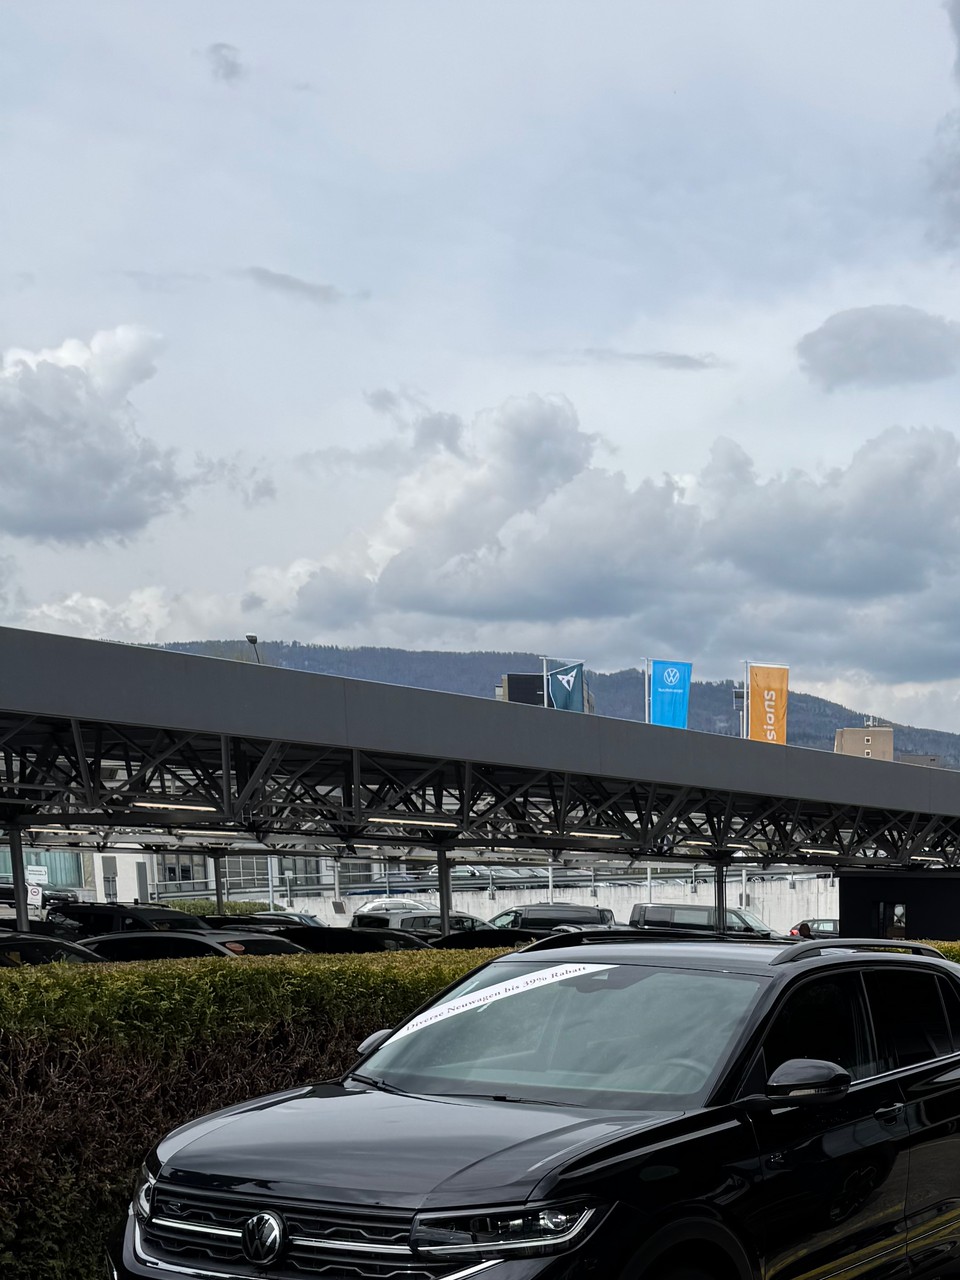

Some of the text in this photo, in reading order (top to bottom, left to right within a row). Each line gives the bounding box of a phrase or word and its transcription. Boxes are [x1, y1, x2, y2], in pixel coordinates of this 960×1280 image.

[763, 690, 777, 743] sions
[407, 1012, 444, 1030] Diverse
[447, 991, 501, 1013] Neuwagen
[504, 984, 520, 993] bis
[551, 966, 587, 979] Rabatt
